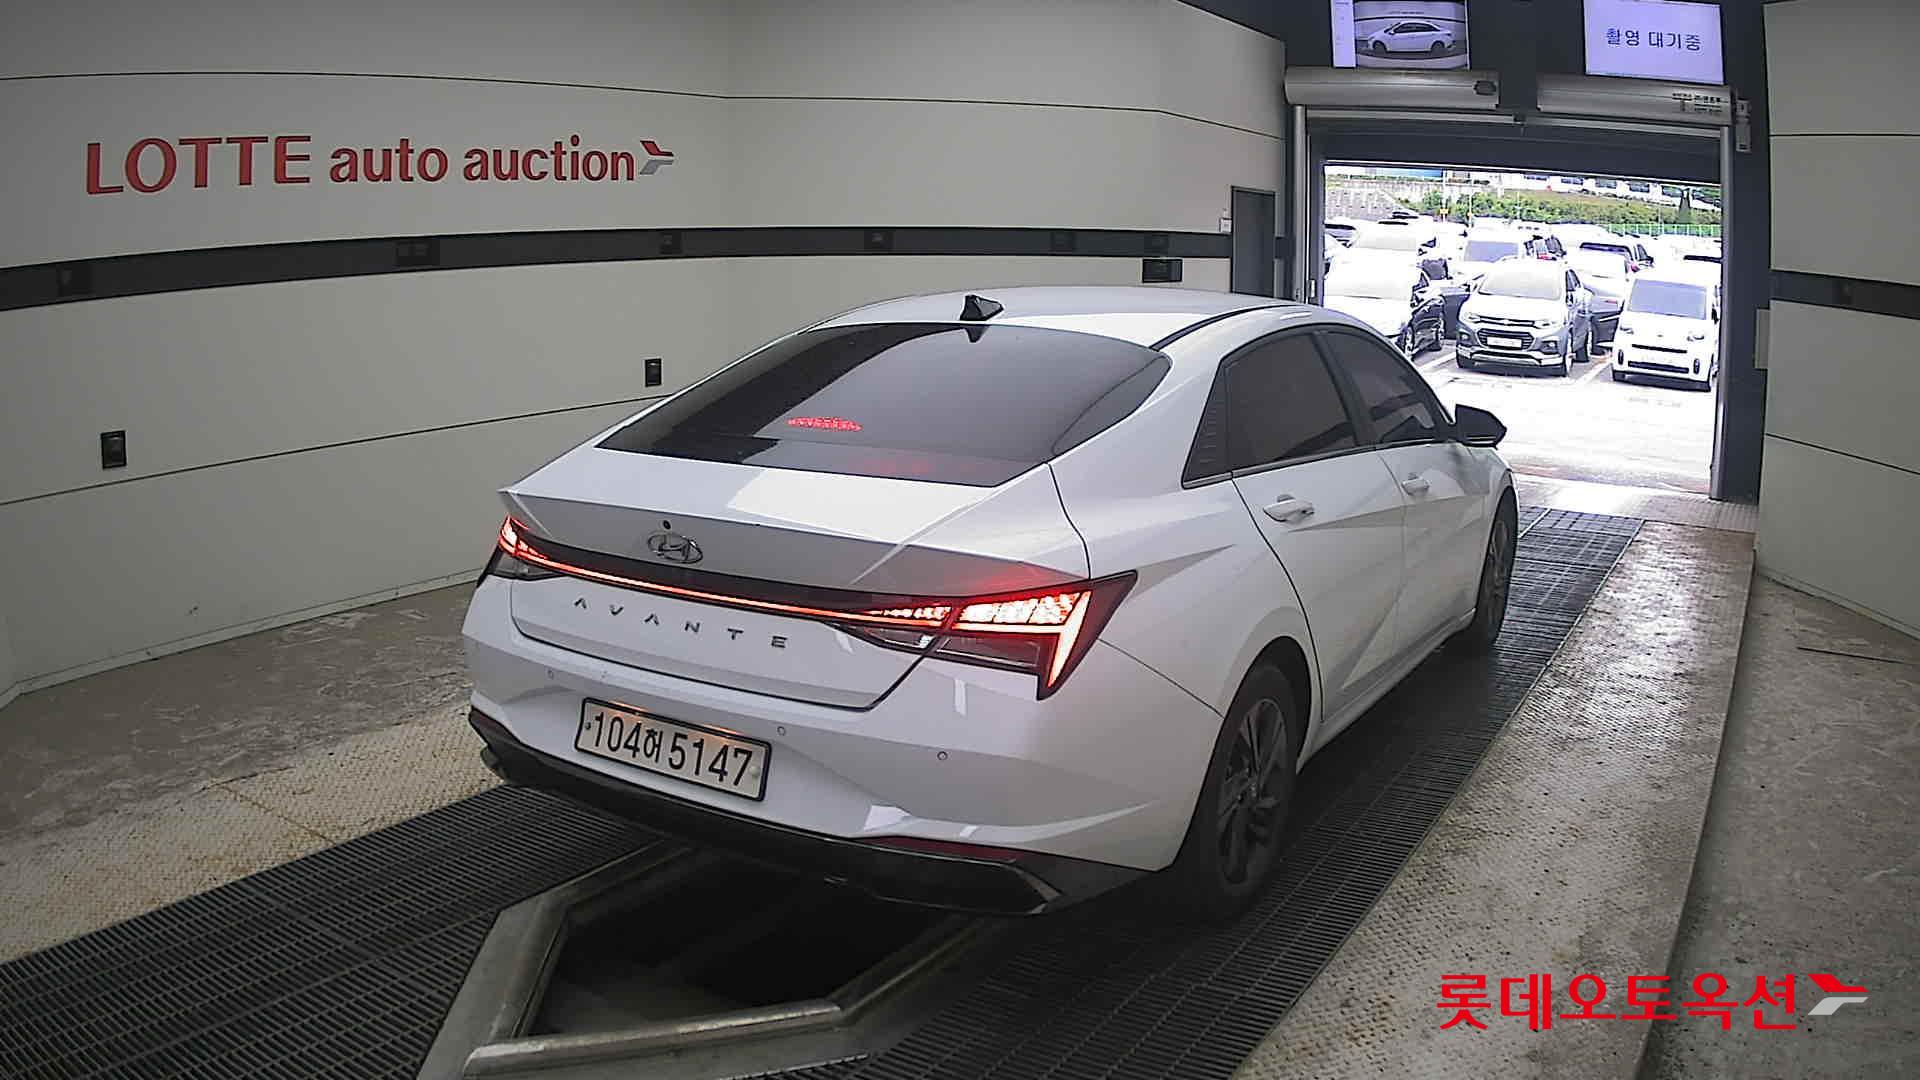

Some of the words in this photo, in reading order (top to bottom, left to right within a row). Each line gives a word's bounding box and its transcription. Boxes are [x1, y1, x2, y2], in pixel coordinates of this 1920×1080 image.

[1607, 28, 1640, 47] 촬영
[1648, 31, 1702, 52] 대기중
[86, 135, 312, 195] LOTTE
[329, 137, 449, 183] auto
[463, 134, 635, 182] auction
[573, 597, 788, 649] AVANTE
